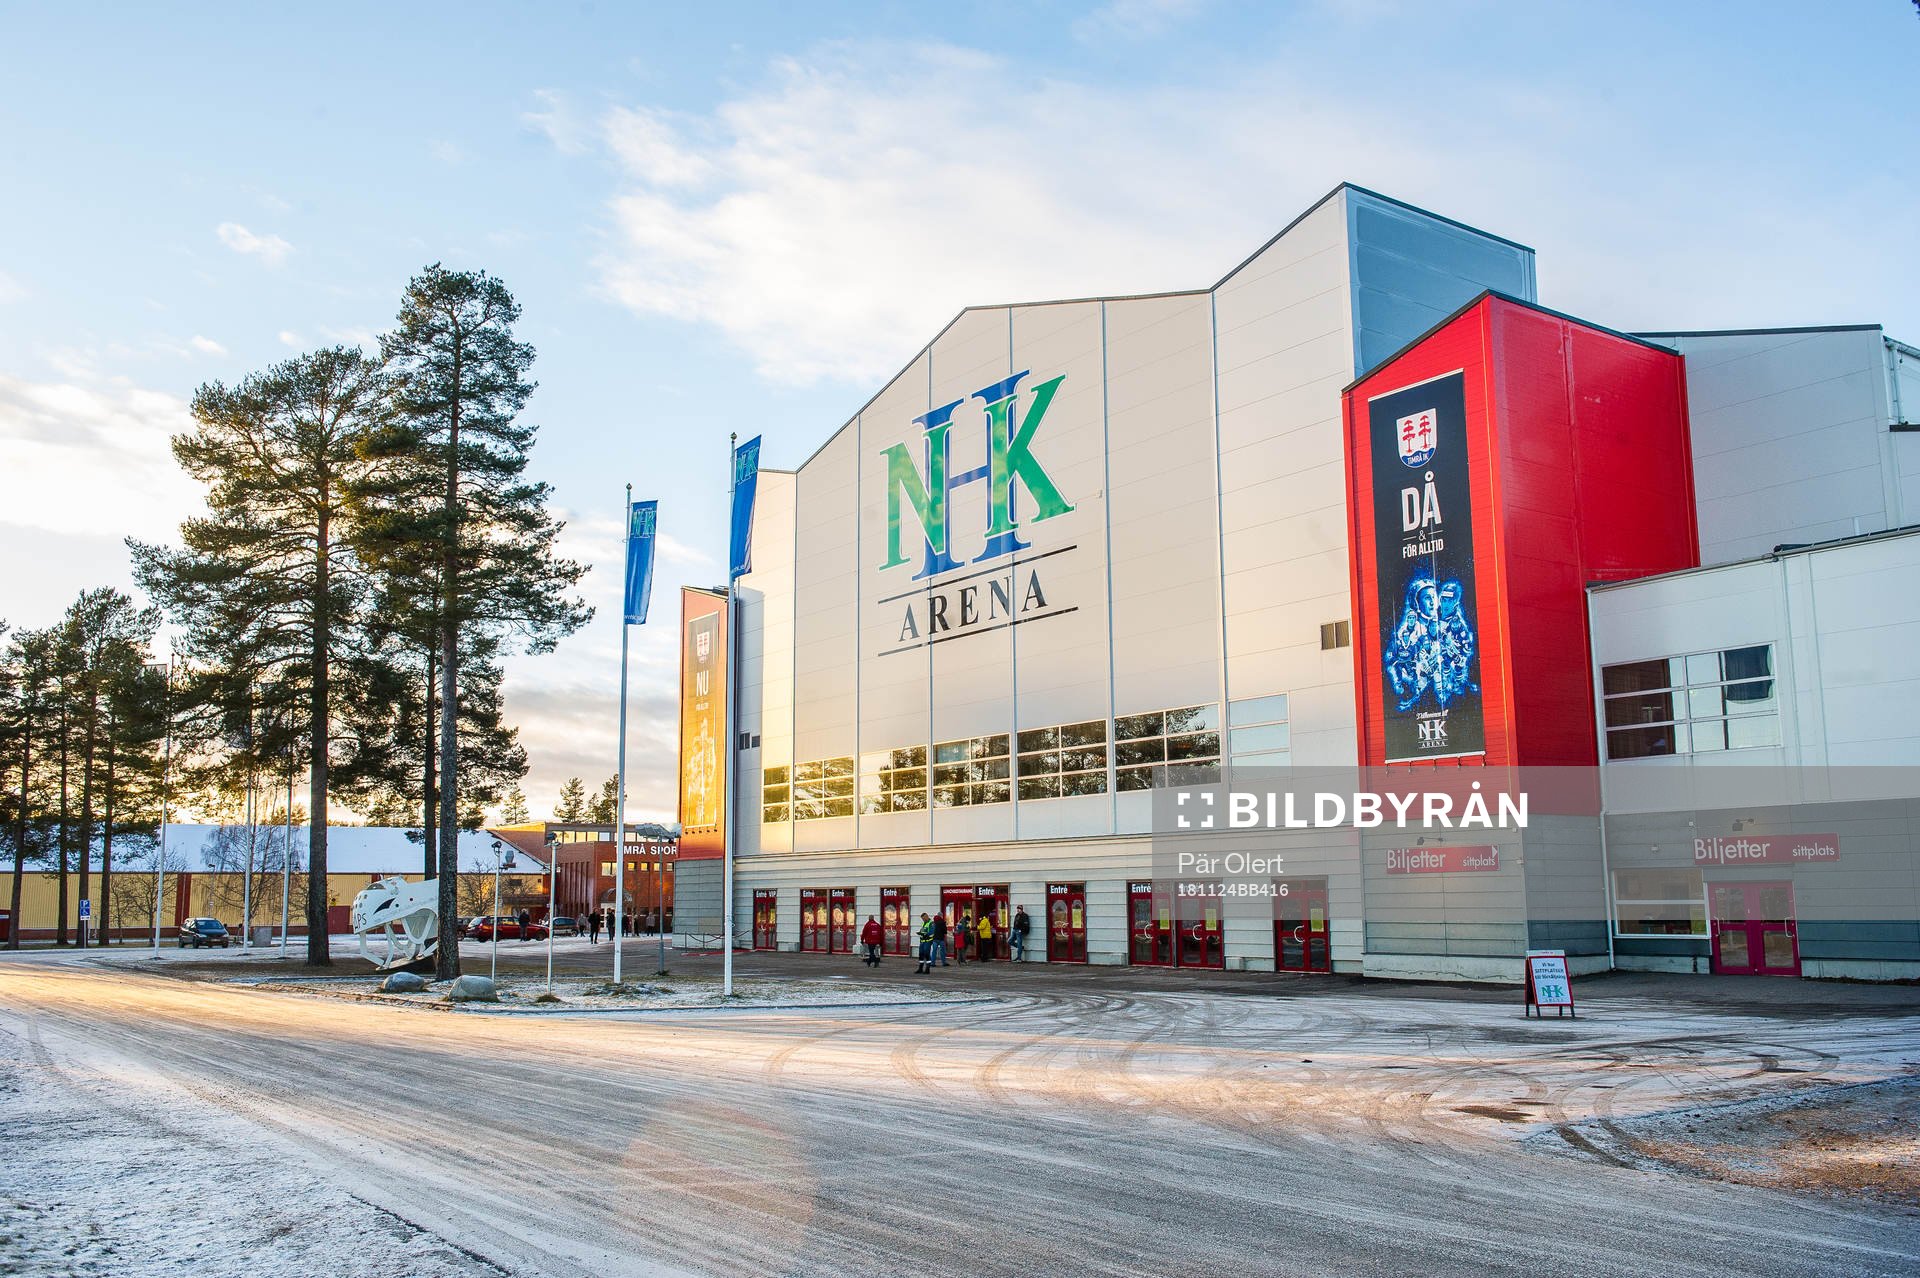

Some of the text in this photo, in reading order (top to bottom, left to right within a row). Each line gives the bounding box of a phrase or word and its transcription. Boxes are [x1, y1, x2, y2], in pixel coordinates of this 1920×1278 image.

[1407, 453, 1422, 465] TIMRÅ
[879, 369, 1075, 582] NHK
[1401, 470, 1442, 532] DÅ
[1418, 530, 1427, 541] &
[1402, 538, 1444, 559] FÖR ALLTID
[898, 568, 1048, 642] ARENA
[696, 669, 709, 697] NU
[1417, 719, 1448, 741] NHK
[1421, 740, 1446, 748] ARENA
[1387, 848, 1496, 873] Biljetter sittplats
[1694, 837, 1835, 864] Biljetter sittplats
[1050, 885, 1068, 894] Entré
[1131, 883, 1152, 893] Entré
